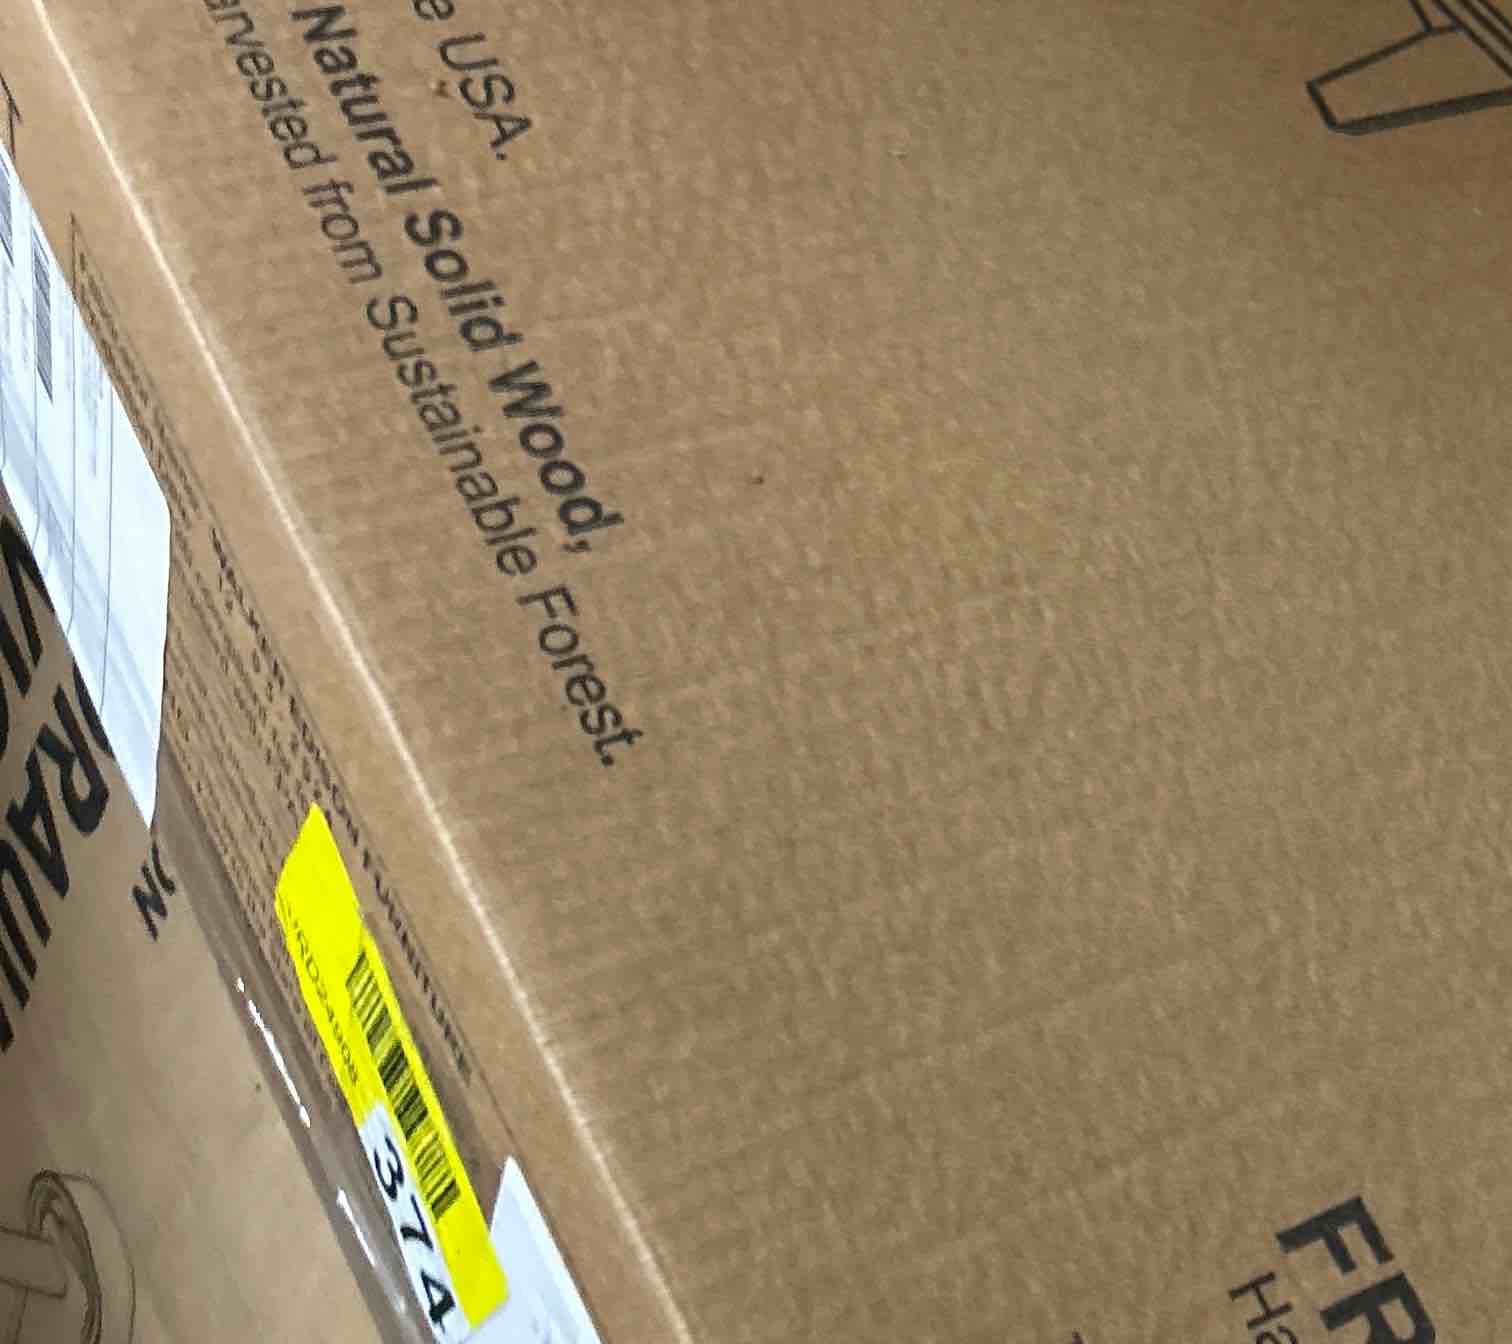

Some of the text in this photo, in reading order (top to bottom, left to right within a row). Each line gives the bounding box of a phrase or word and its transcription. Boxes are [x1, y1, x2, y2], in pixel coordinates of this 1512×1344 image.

[291, 5, 441, 195] Natural
[404, 208, 523, 352] Solid
[488, 360, 624, 553] Wood,
[437, 32, 532, 161] USA.
[302, 179, 382, 284] from
[365, 296, 537, 576] Sustainable
[516, 584, 644, 768] Forest.
[373, 1136, 456, 1333] 374
